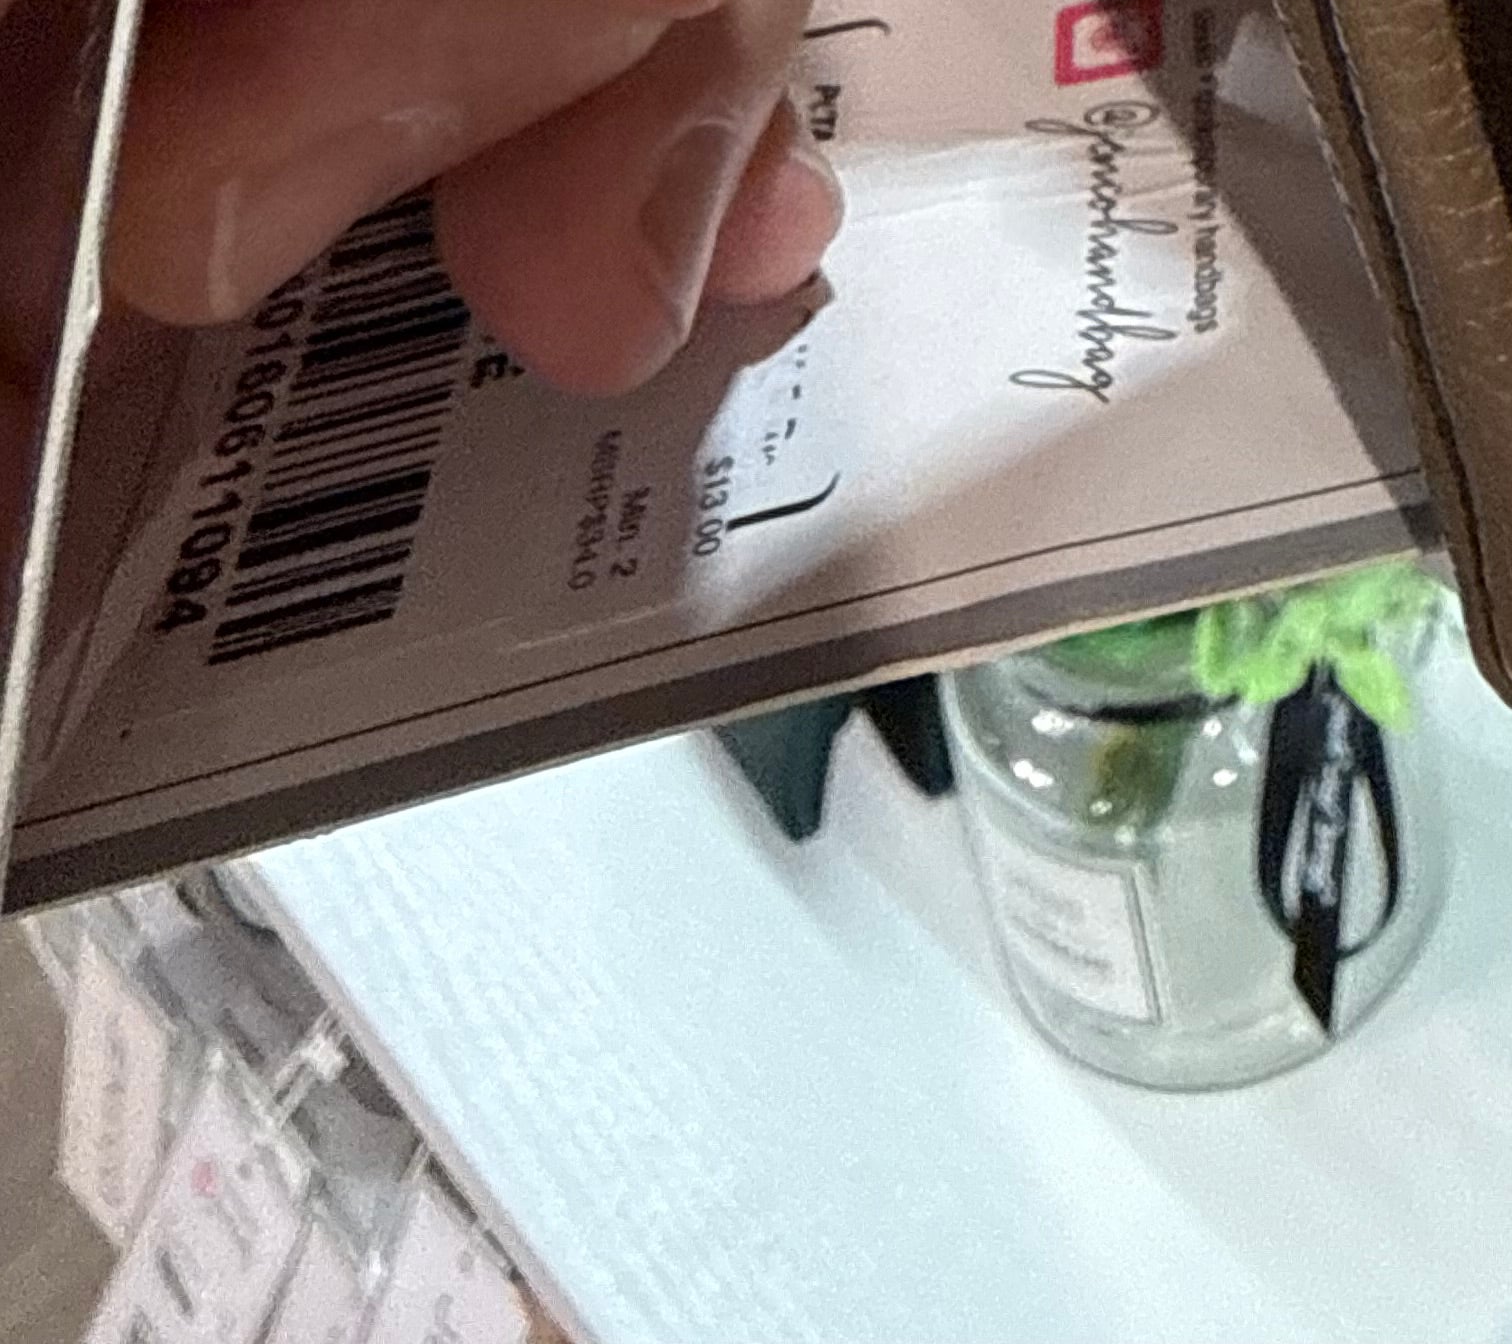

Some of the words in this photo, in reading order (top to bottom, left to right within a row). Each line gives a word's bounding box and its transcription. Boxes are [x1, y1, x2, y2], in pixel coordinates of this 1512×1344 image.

[1186, 223, 1224, 334] handbags
[691, 455, 735, 558] $1300
[607, 557, 639, 578] 2
